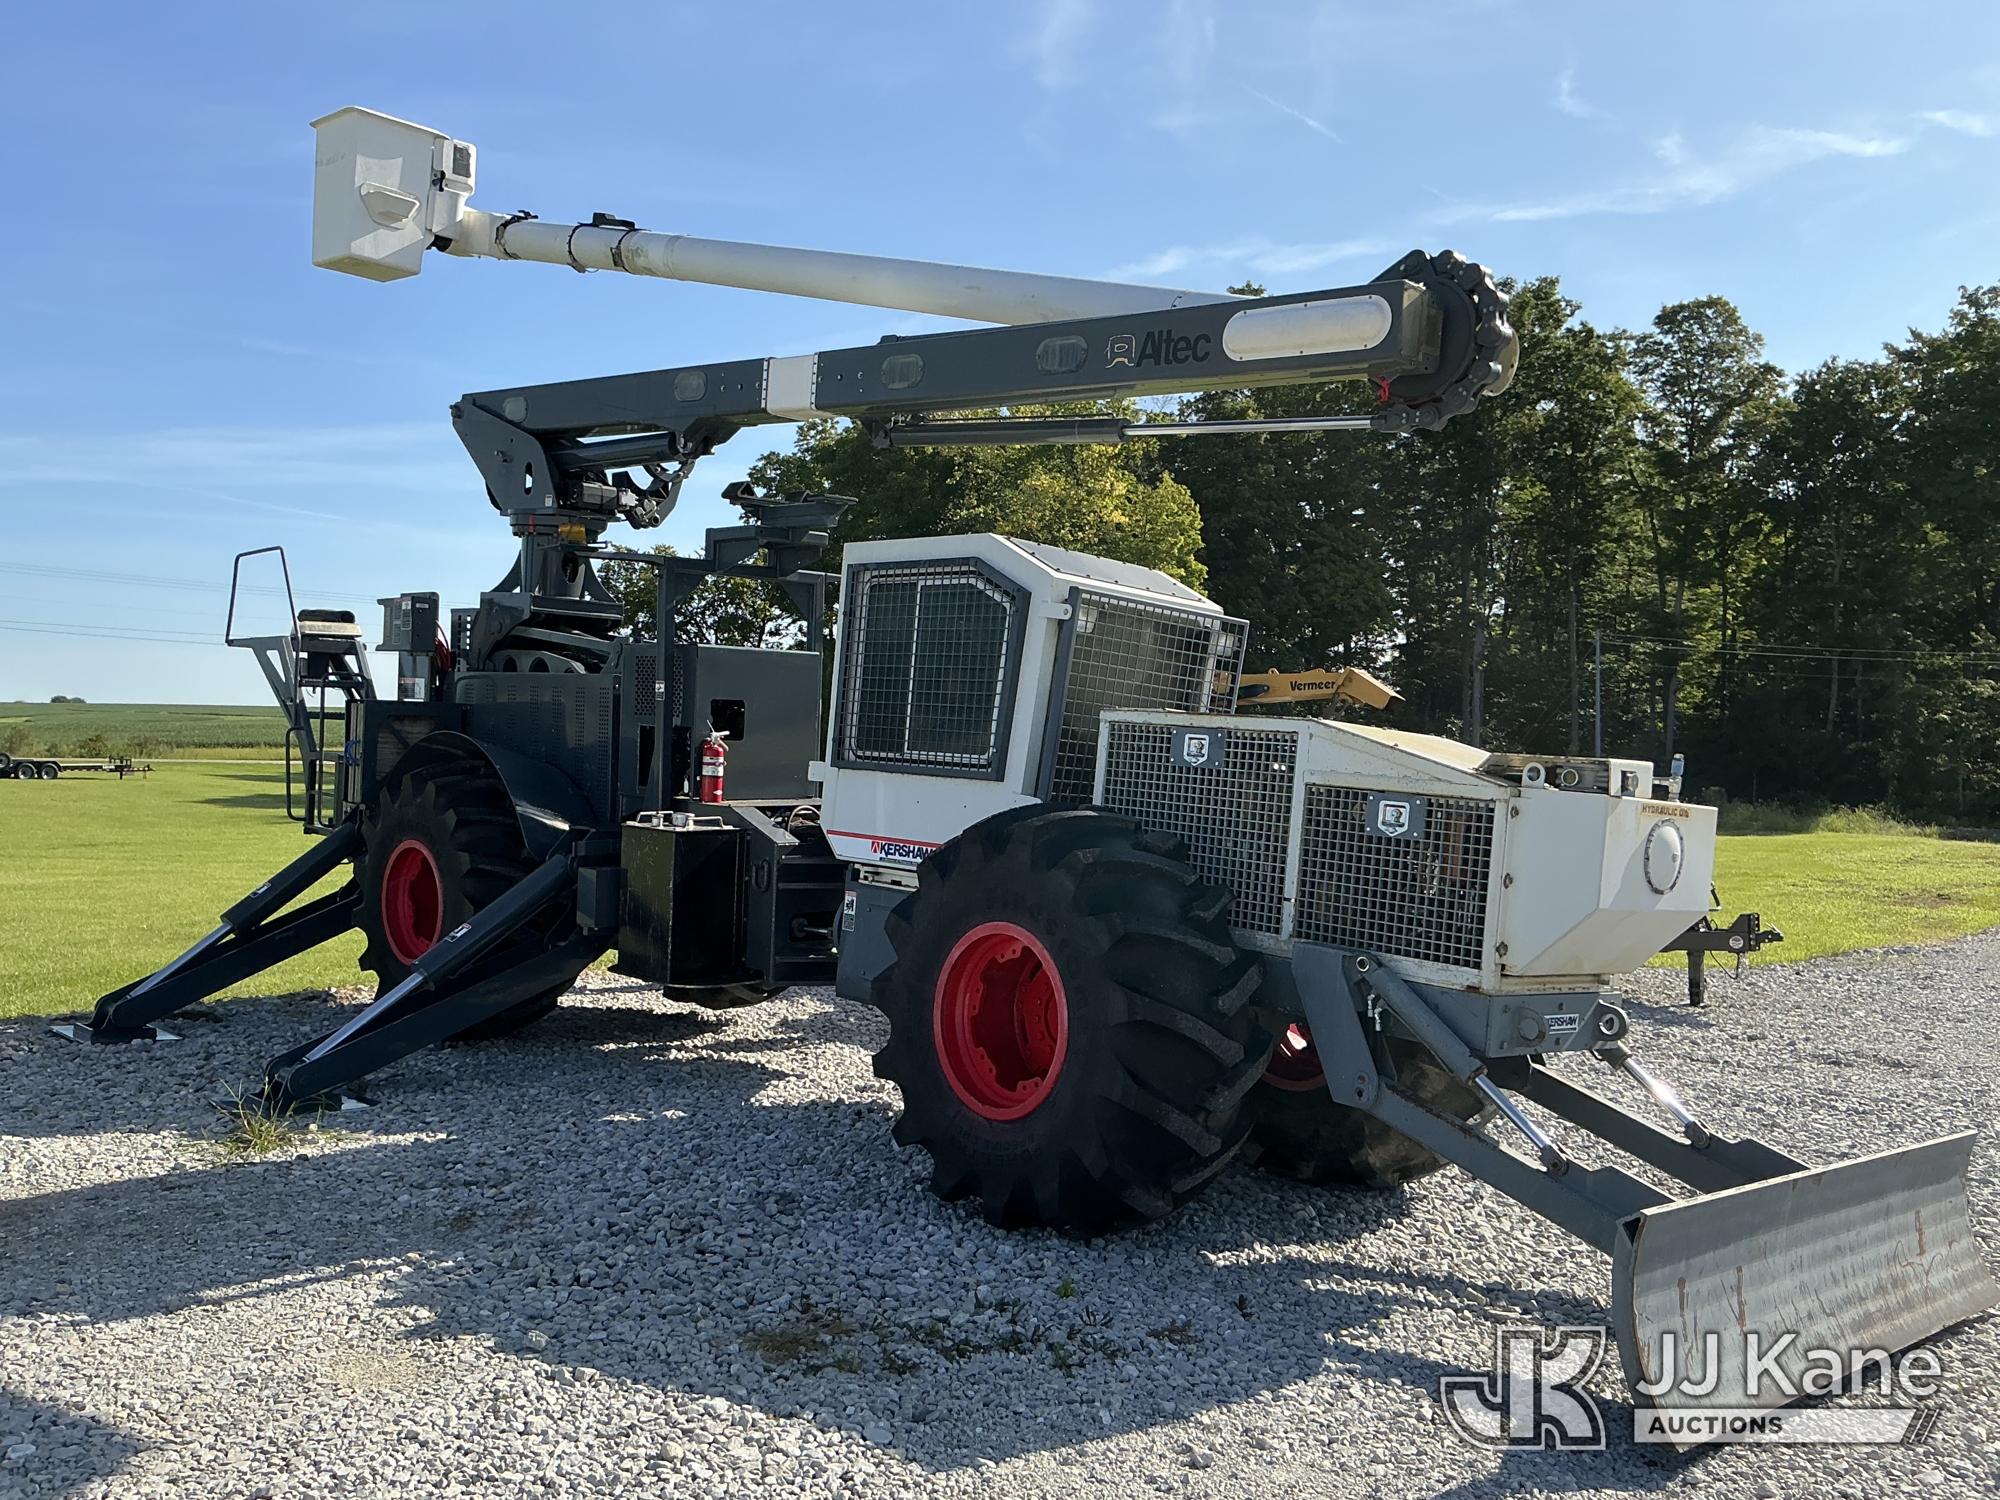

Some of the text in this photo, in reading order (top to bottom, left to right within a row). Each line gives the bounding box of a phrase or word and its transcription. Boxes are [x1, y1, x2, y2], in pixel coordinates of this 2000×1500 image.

[1136, 329, 1212, 368] Altec
[1289, 680, 1336, 691] Vermeer
[1642, 804, 1678, 816] HYDRAULIC
[880, 842, 936, 859] KERSHAW
